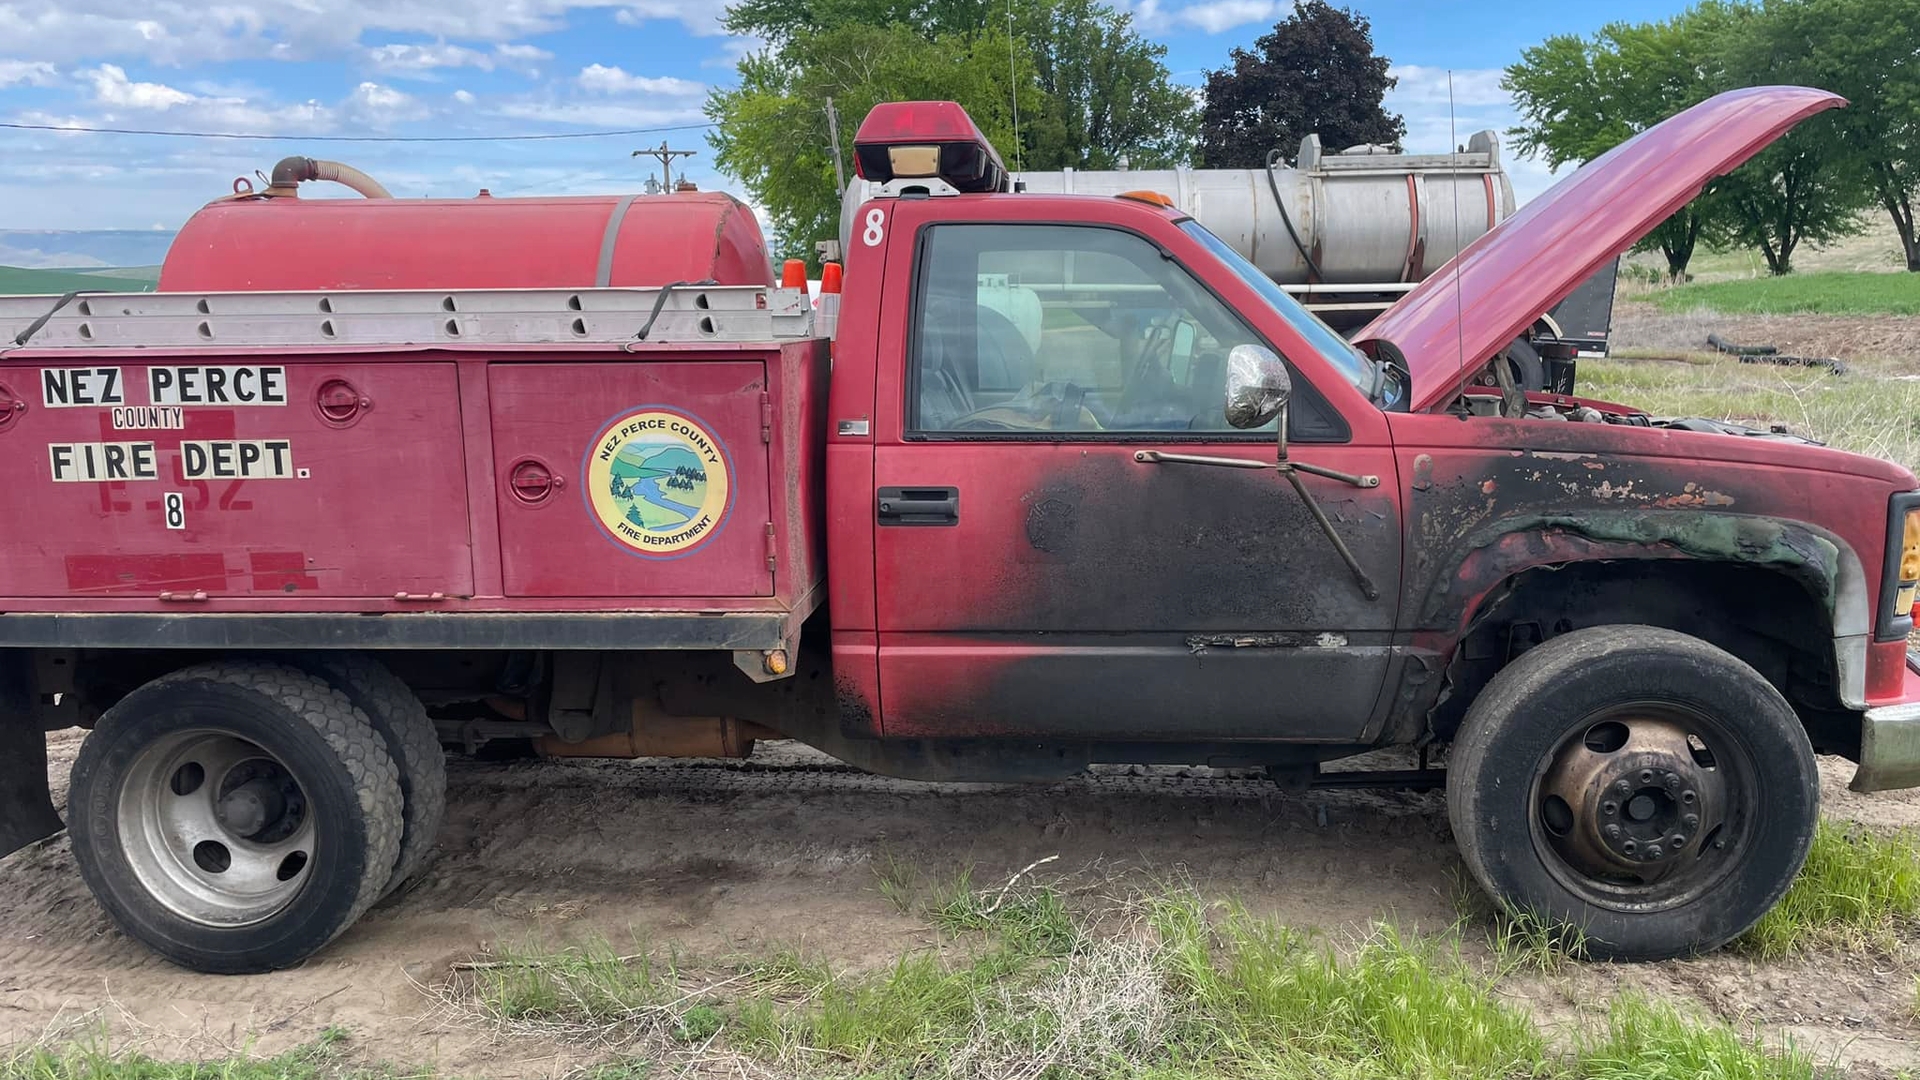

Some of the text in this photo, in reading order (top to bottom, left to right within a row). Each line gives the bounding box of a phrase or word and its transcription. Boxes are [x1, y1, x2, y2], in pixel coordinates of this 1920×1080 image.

[863, 208, 885, 246] 8
[45, 367, 285, 404] NEZ PERCE
[114, 408, 182, 428] COUNTY
[600, 419, 719, 464] NEZ PERCE COUNTY
[52, 442, 307, 479] FIRE DEPT.
[167, 494, 182, 527] 8
[617, 515, 712, 545] FIRE DEPARTMENT
